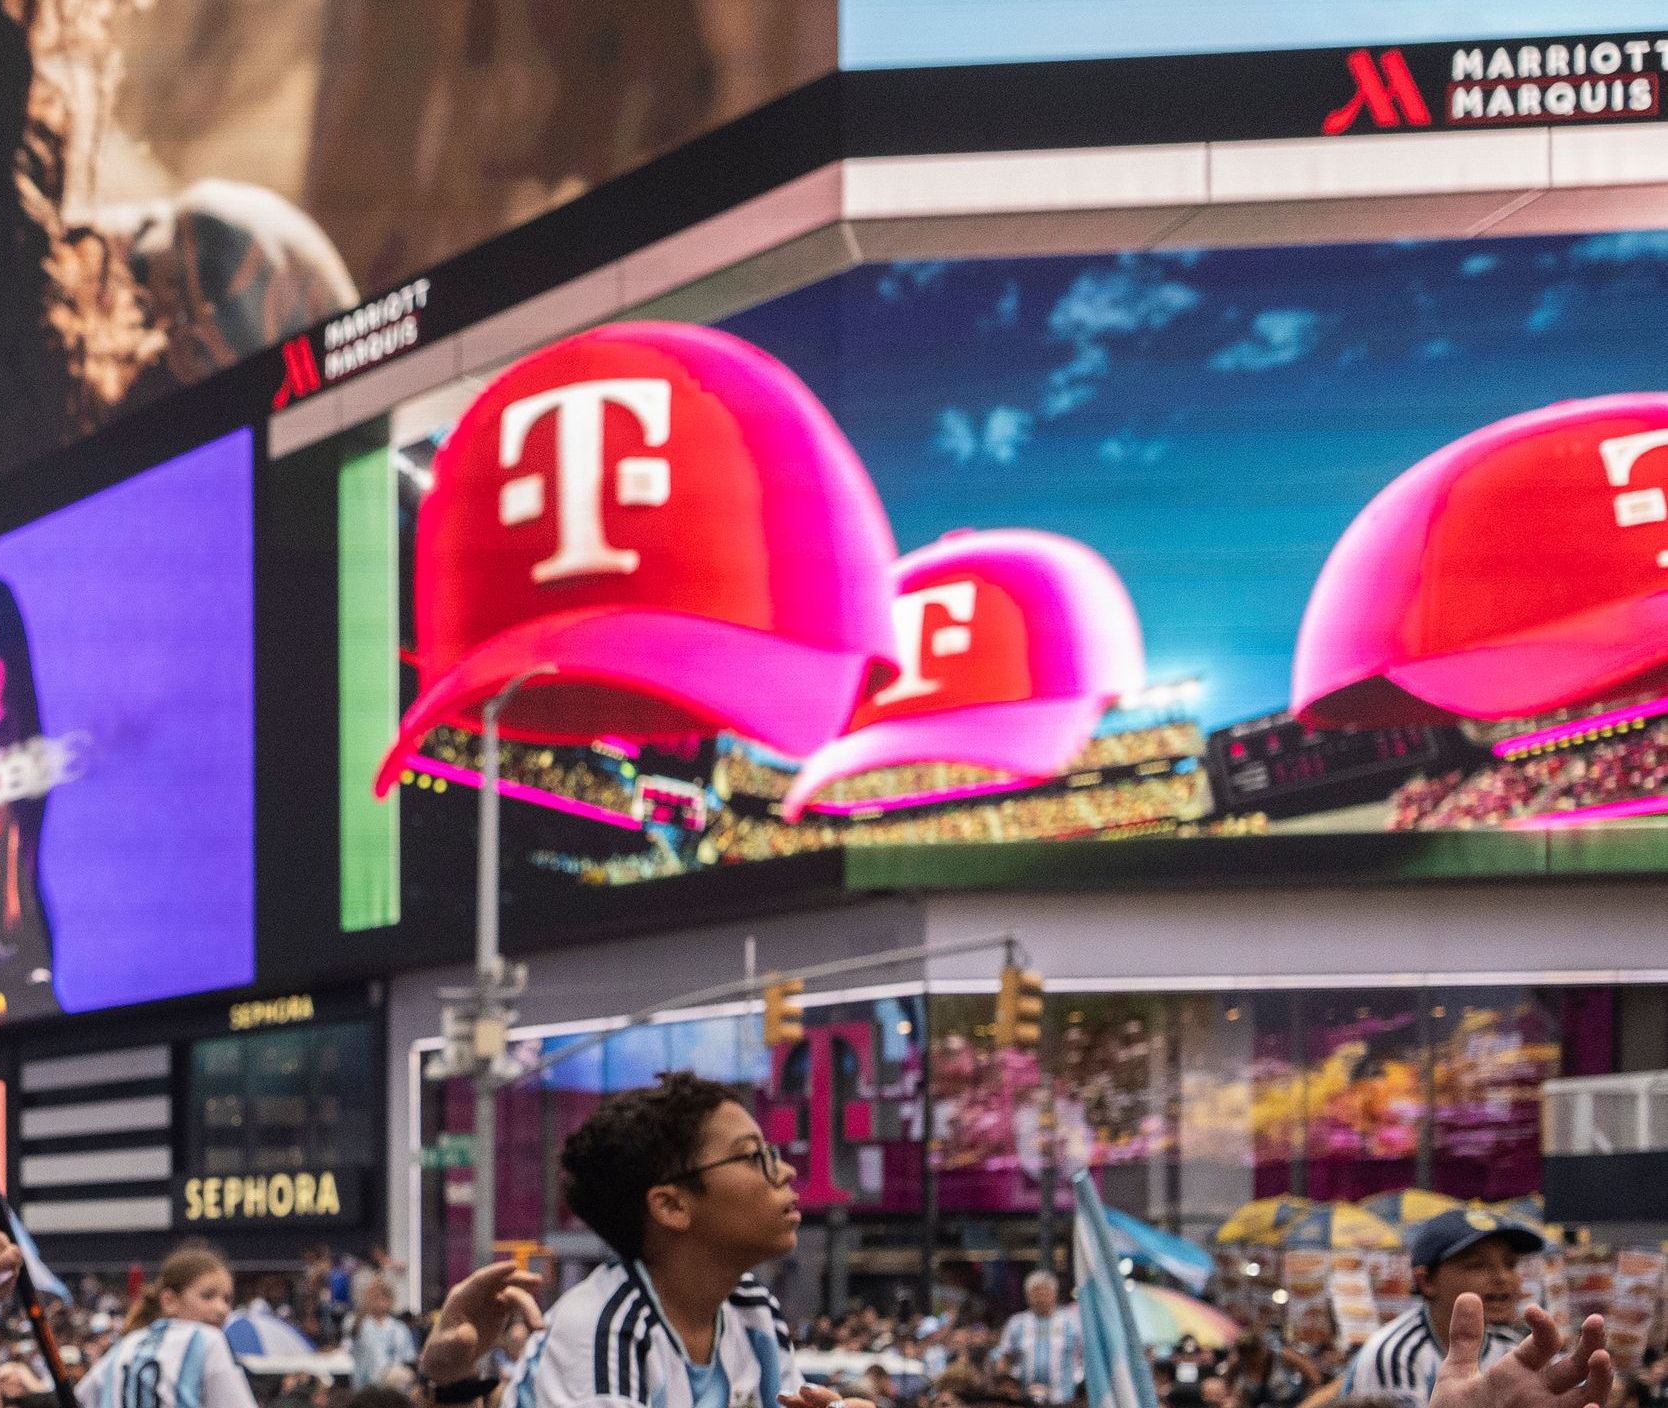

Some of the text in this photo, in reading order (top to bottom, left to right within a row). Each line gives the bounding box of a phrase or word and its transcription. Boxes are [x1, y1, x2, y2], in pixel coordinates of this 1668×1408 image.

[1451, 39, 1668, 82] MARRIOTT
[1451, 77, 1652, 119] MARQUIS
[324, 278, 431, 353] MARRIOTT
[324, 314, 418, 381] MARQUIS
[499, 378, 672, 584] T
[229, 994, 315, 1034] SEPHORA
[184, 1171, 341, 1222] SEPHORA
